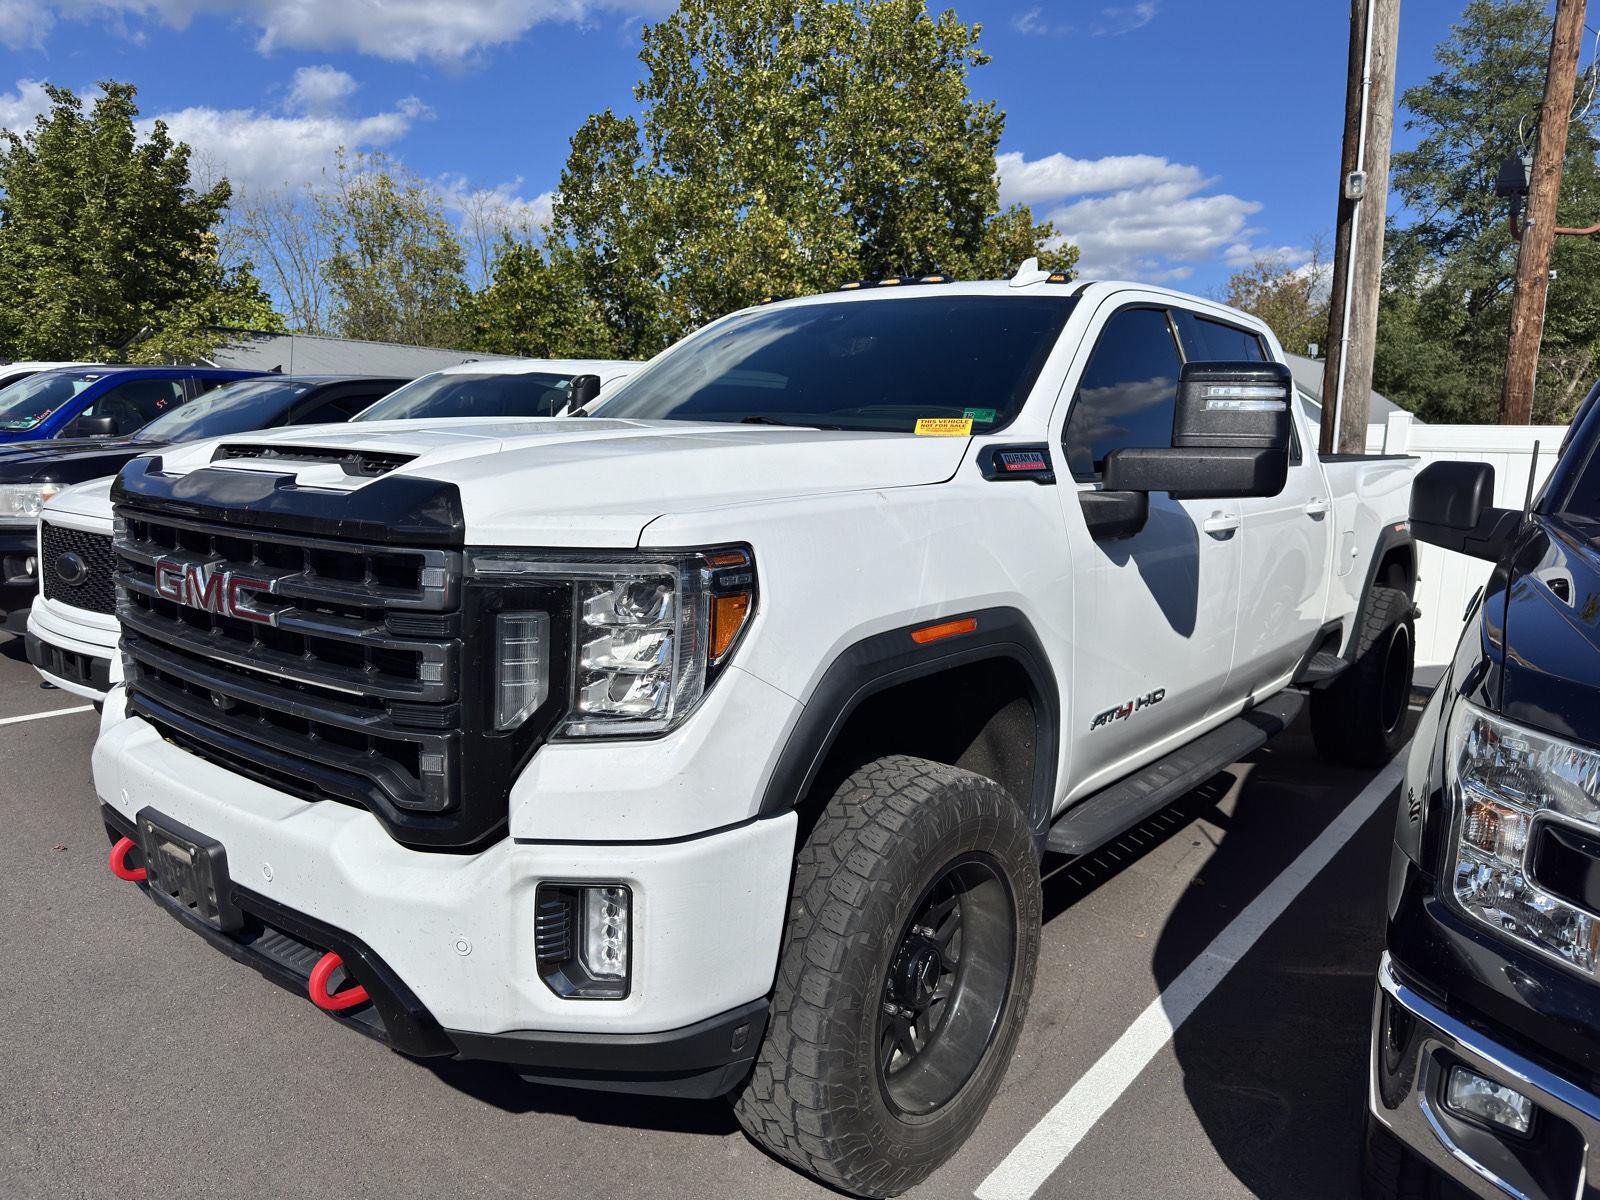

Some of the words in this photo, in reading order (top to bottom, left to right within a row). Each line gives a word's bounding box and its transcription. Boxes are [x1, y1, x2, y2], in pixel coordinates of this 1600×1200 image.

[1003, 453, 1041, 464] DURAMAX
[155, 557, 278, 627] GMC
[1089, 701, 1133, 731] AT4
[1134, 688, 1166, 711] HD
